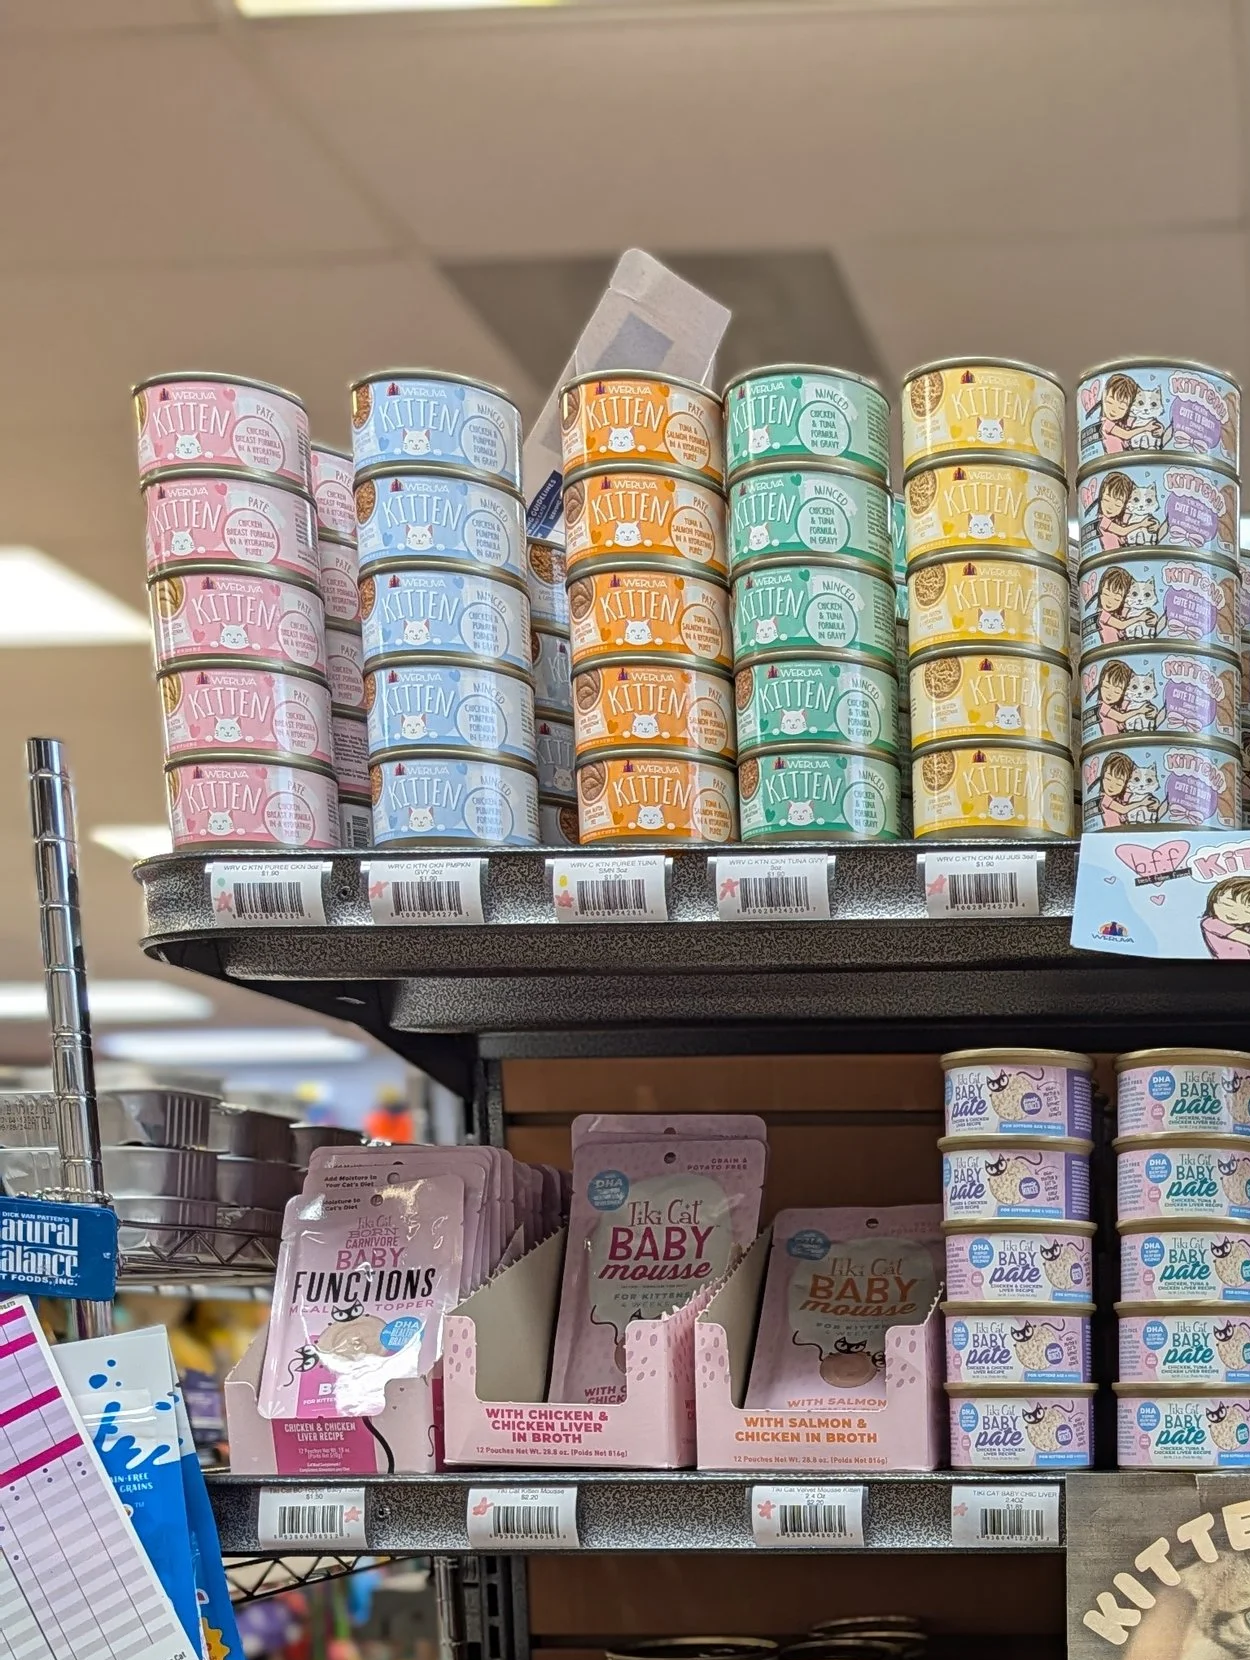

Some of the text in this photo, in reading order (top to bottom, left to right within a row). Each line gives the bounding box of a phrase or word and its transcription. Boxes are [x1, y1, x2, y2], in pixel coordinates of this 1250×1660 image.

[815, 387, 849, 410] MINCED
[731, 394, 798, 436] KITTEN
[809, 409, 836, 419] CHICKEN
[819, 420, 837, 429] TUNA
[810, 430, 839, 439] FORMULA
[810, 439, 840, 450] IN GRAVY
[628, 1199, 703, 1227] Tiki Cat
[350, 1228, 399, 1238] BORN
[346, 1236, 399, 1248] CARNIVORE
[608, 1226, 715, 1261] BABY
[336, 1247, 405, 1270] BABY
[998, 1251, 1037, 1266] BABY
[599, 1261, 713, 1280] mousse
[989, 1264, 1041, 1284] pate
[292, 1268, 436, 1303] FUNCTIONS
[376, 1300, 434, 1311] TOPPER
[486, 1408, 608, 1421] WITH CHICKEN &
[491, 1420, 603, 1432] CHICKEN LIVER
[511, 1431, 582, 1443] IN BROTH
